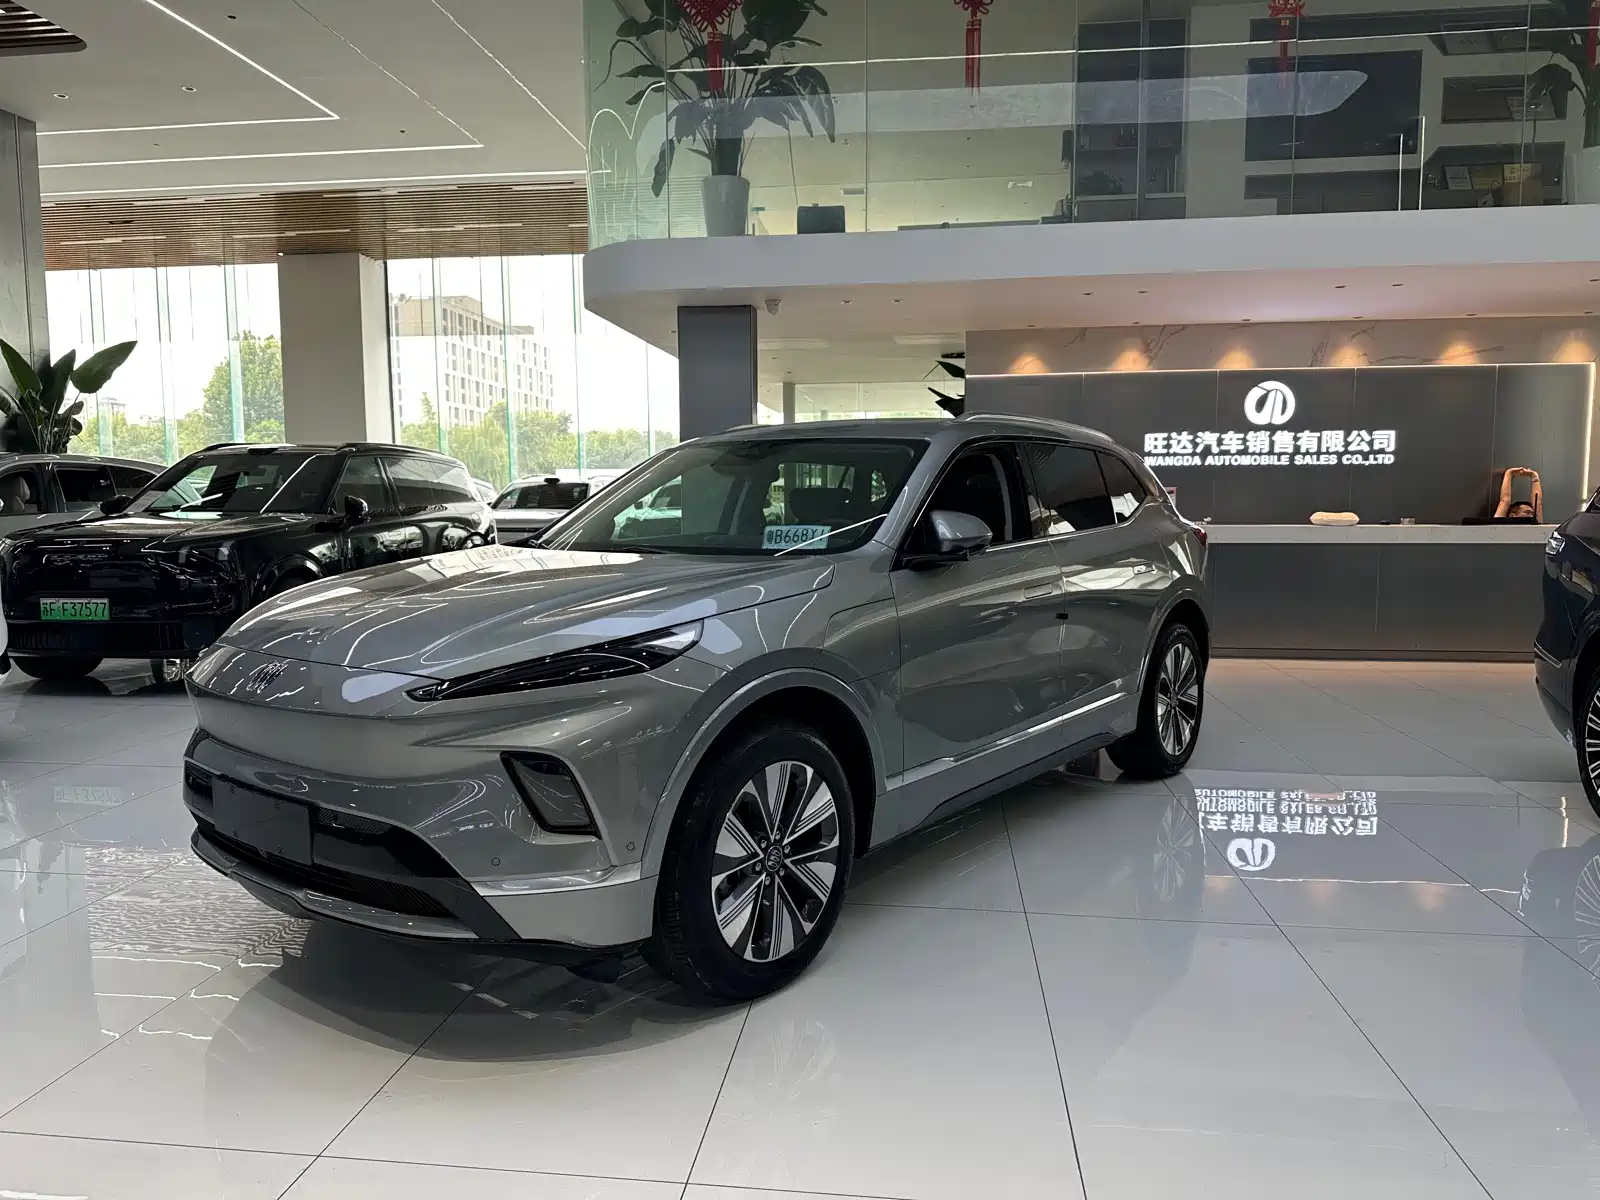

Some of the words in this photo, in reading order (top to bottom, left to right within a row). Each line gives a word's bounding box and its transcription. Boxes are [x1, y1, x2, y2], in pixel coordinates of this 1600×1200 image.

[1143, 430, 1396, 454] 旺达汽车销售有限公司
[1143, 456, 1202, 467] WANGDA
[1204, 455, 1290, 466] AUTOMOBILE
[1293, 454, 1338, 465] SALES
